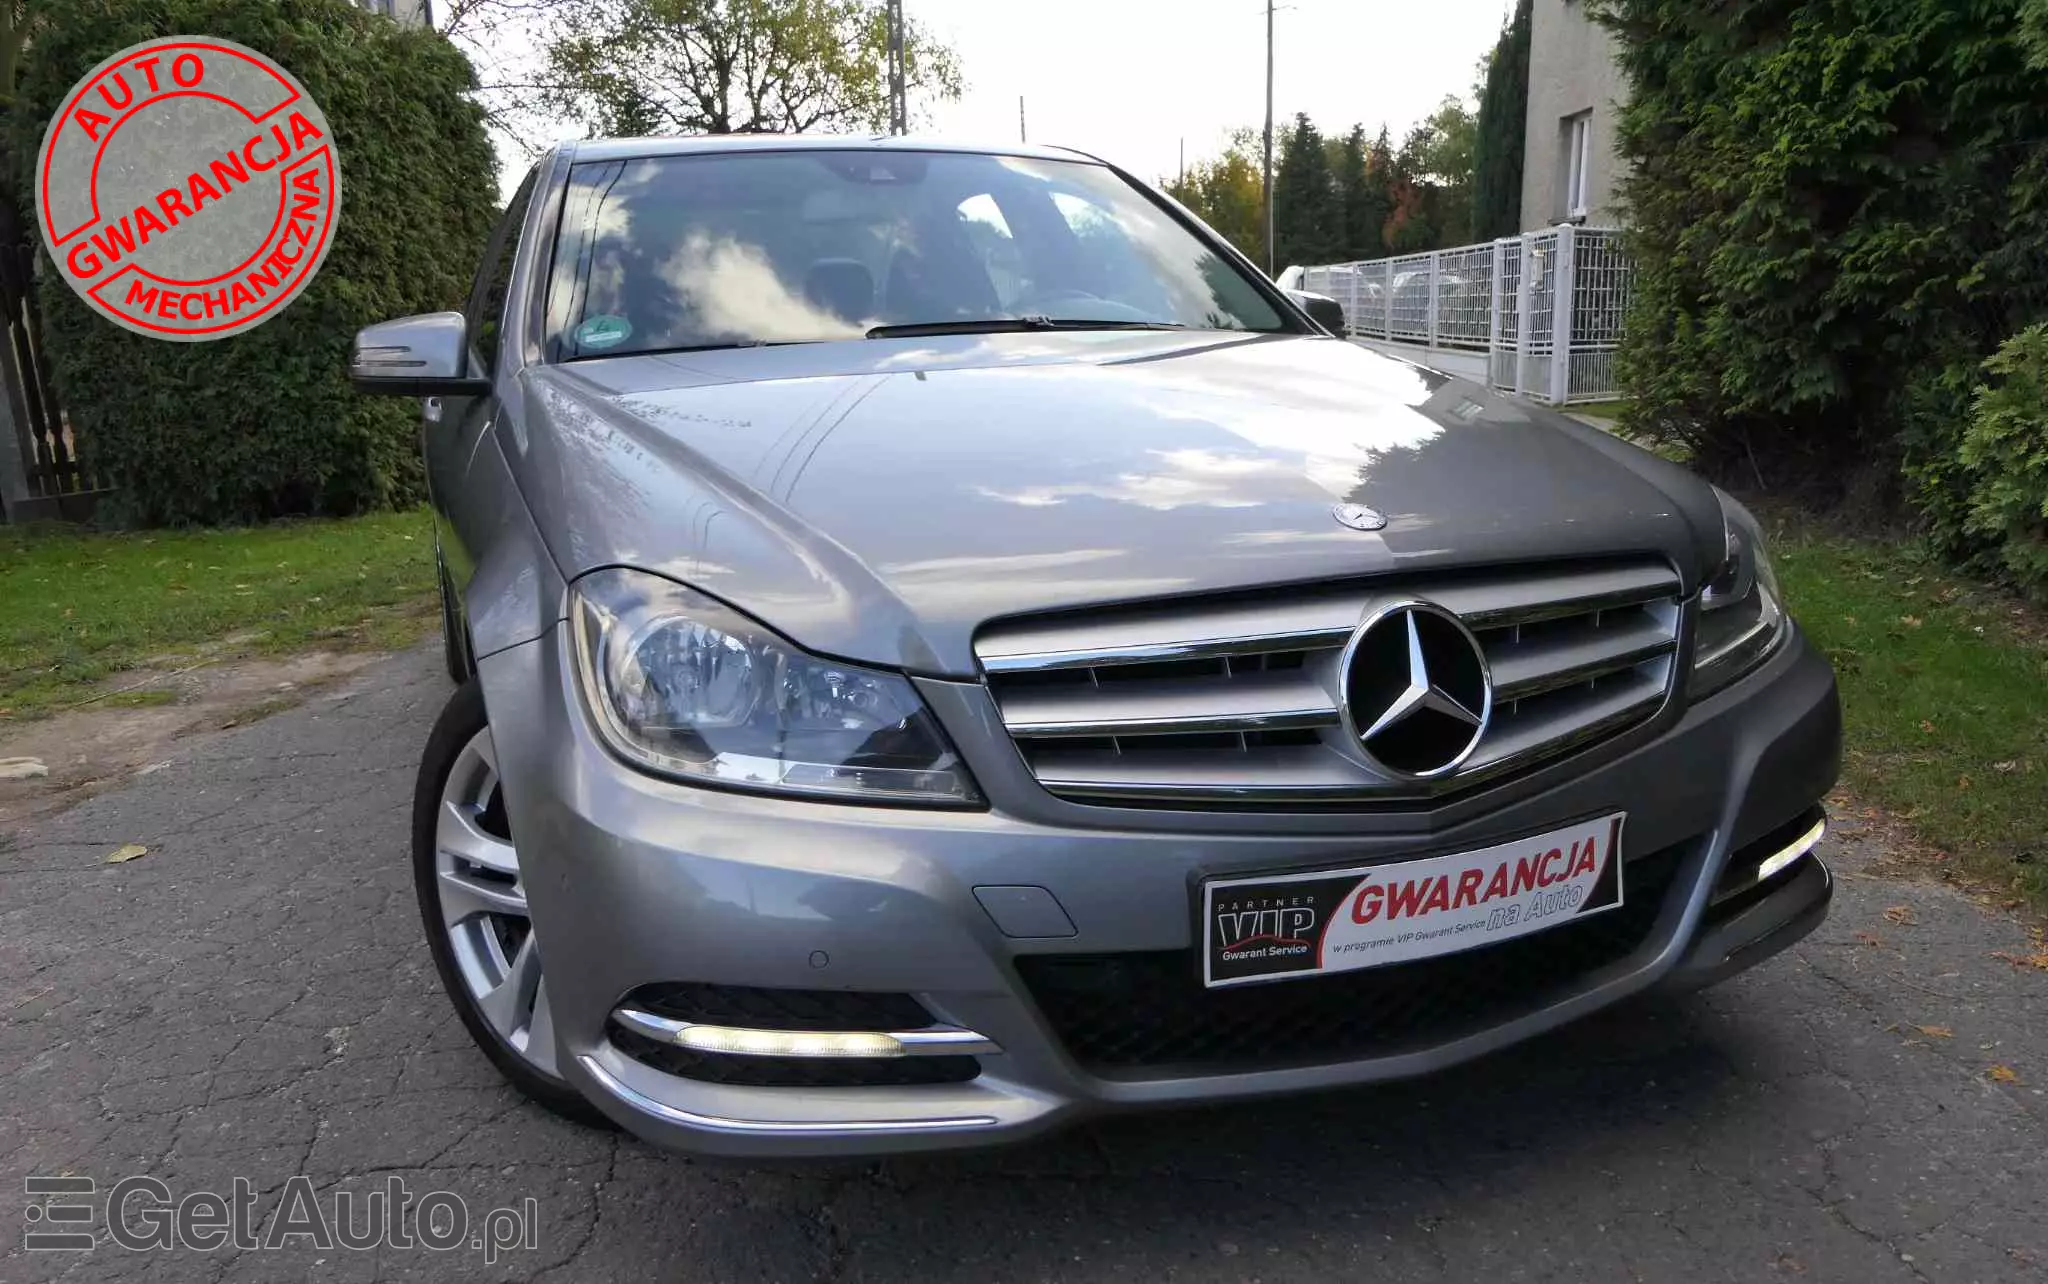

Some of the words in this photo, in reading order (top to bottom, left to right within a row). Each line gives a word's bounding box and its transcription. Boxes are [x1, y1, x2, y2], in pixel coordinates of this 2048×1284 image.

[1351, 836, 1596, 925] GWARANCJA
[1217, 896, 1315, 912] PARTNER
[1486, 904, 1520, 931] na
[1523, 885, 1584, 922] Auto
[1217, 907, 1315, 947] VIP
[1333, 943, 1342, 953] w
[1343, 936, 1394, 953] programie
[1397, 932, 1414, 944] VIP
[1415, 926, 1452, 941] Gwarant
[1454, 919, 1486, 935] Service
[1222, 948, 1267, 961] Gwarant
[1268, 944, 1308, 957] Service
